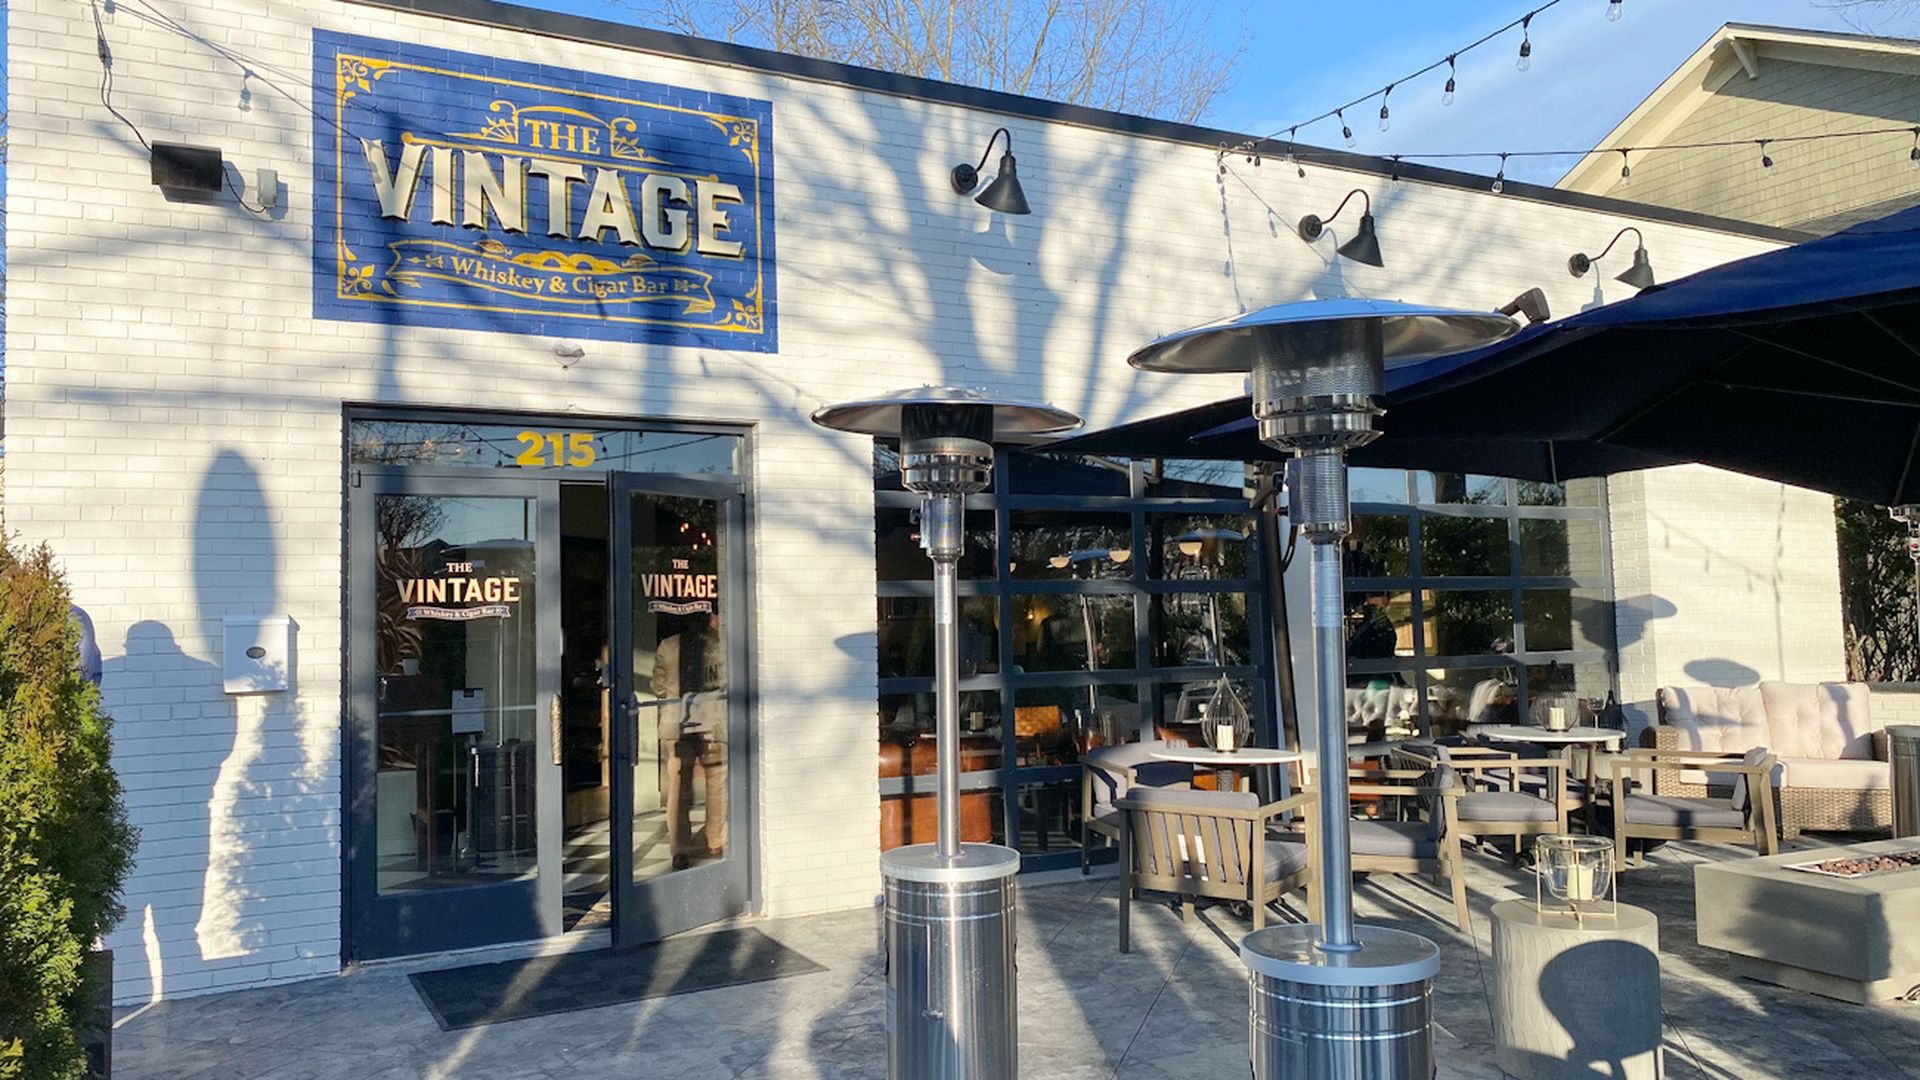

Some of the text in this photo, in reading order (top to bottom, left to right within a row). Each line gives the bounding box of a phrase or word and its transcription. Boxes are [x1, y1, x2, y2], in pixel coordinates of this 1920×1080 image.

[524, 119, 601, 155] THE
[360, 136, 744, 257] VINTAGE
[451, 255, 668, 298] Whiskey & Cigar Bar
[515, 431, 597, 468] 215
[446, 562, 473, 573] THE
[672, 558, 689, 569] THE
[396, 577, 520, 603] VINTAGE
[641, 574, 718, 598] VINTAGE
